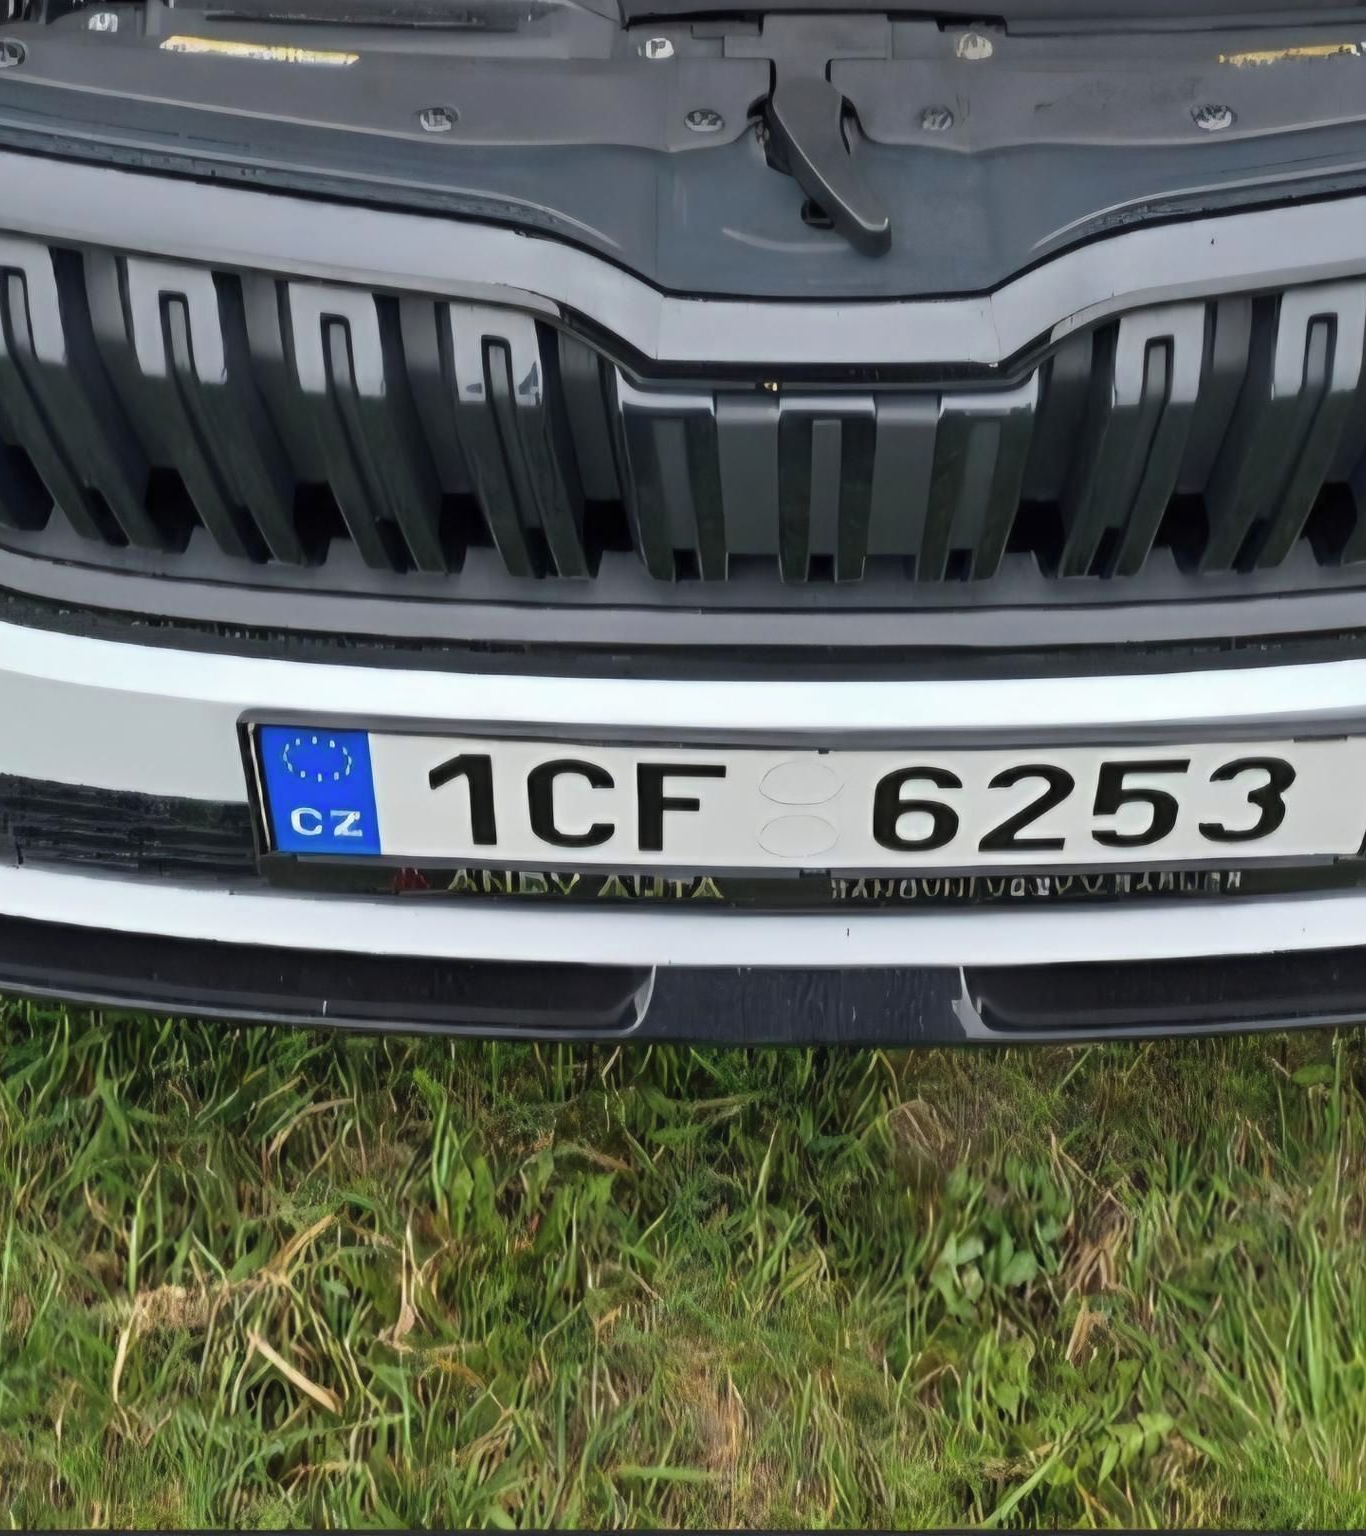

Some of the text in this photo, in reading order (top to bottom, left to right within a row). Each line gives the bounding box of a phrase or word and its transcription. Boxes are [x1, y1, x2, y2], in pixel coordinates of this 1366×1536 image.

[290, 806, 364, 837] CZ
[428, 753, 1297, 852] 1CF 6253
